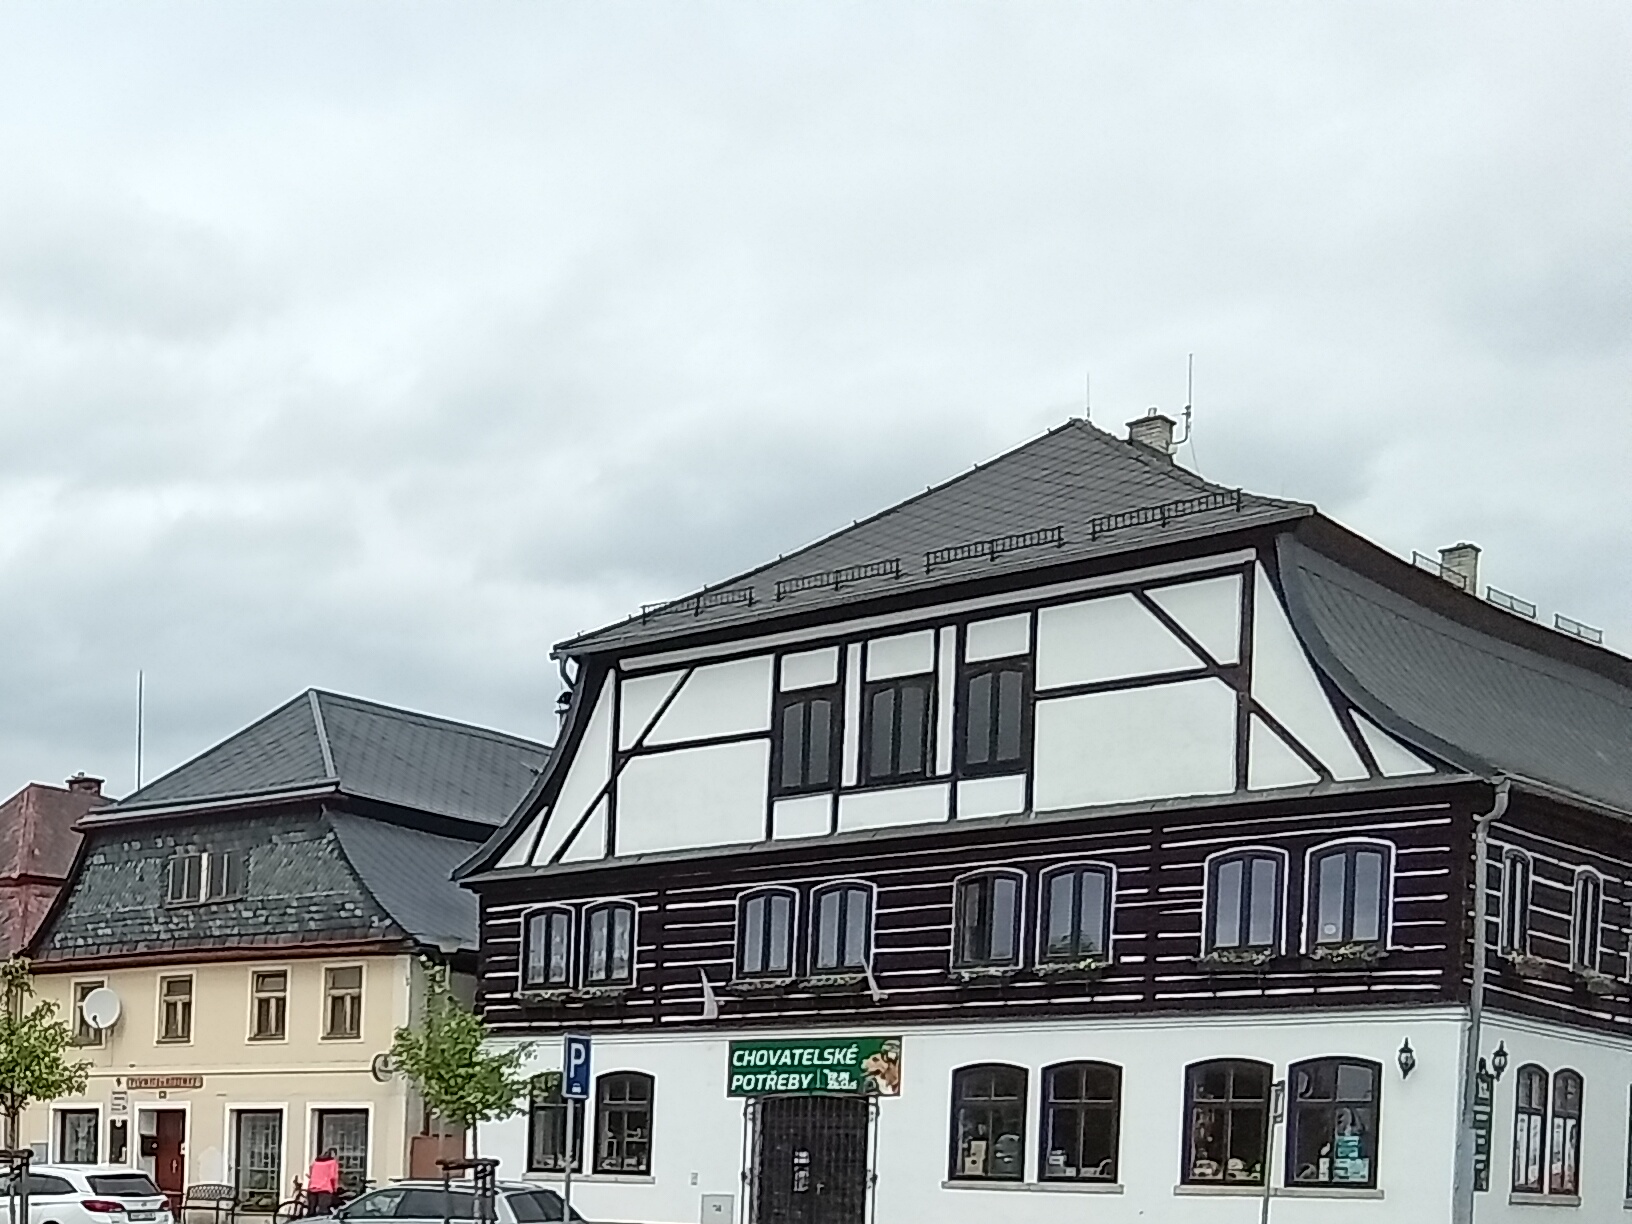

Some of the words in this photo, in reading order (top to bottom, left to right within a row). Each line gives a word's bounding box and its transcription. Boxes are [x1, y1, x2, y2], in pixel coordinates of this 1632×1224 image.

[570, 1043, 586, 1078] P
[732, 1044, 859, 1066] CHOVATELSKÉ
[731, 1070, 814, 1091] POTŘEBY
